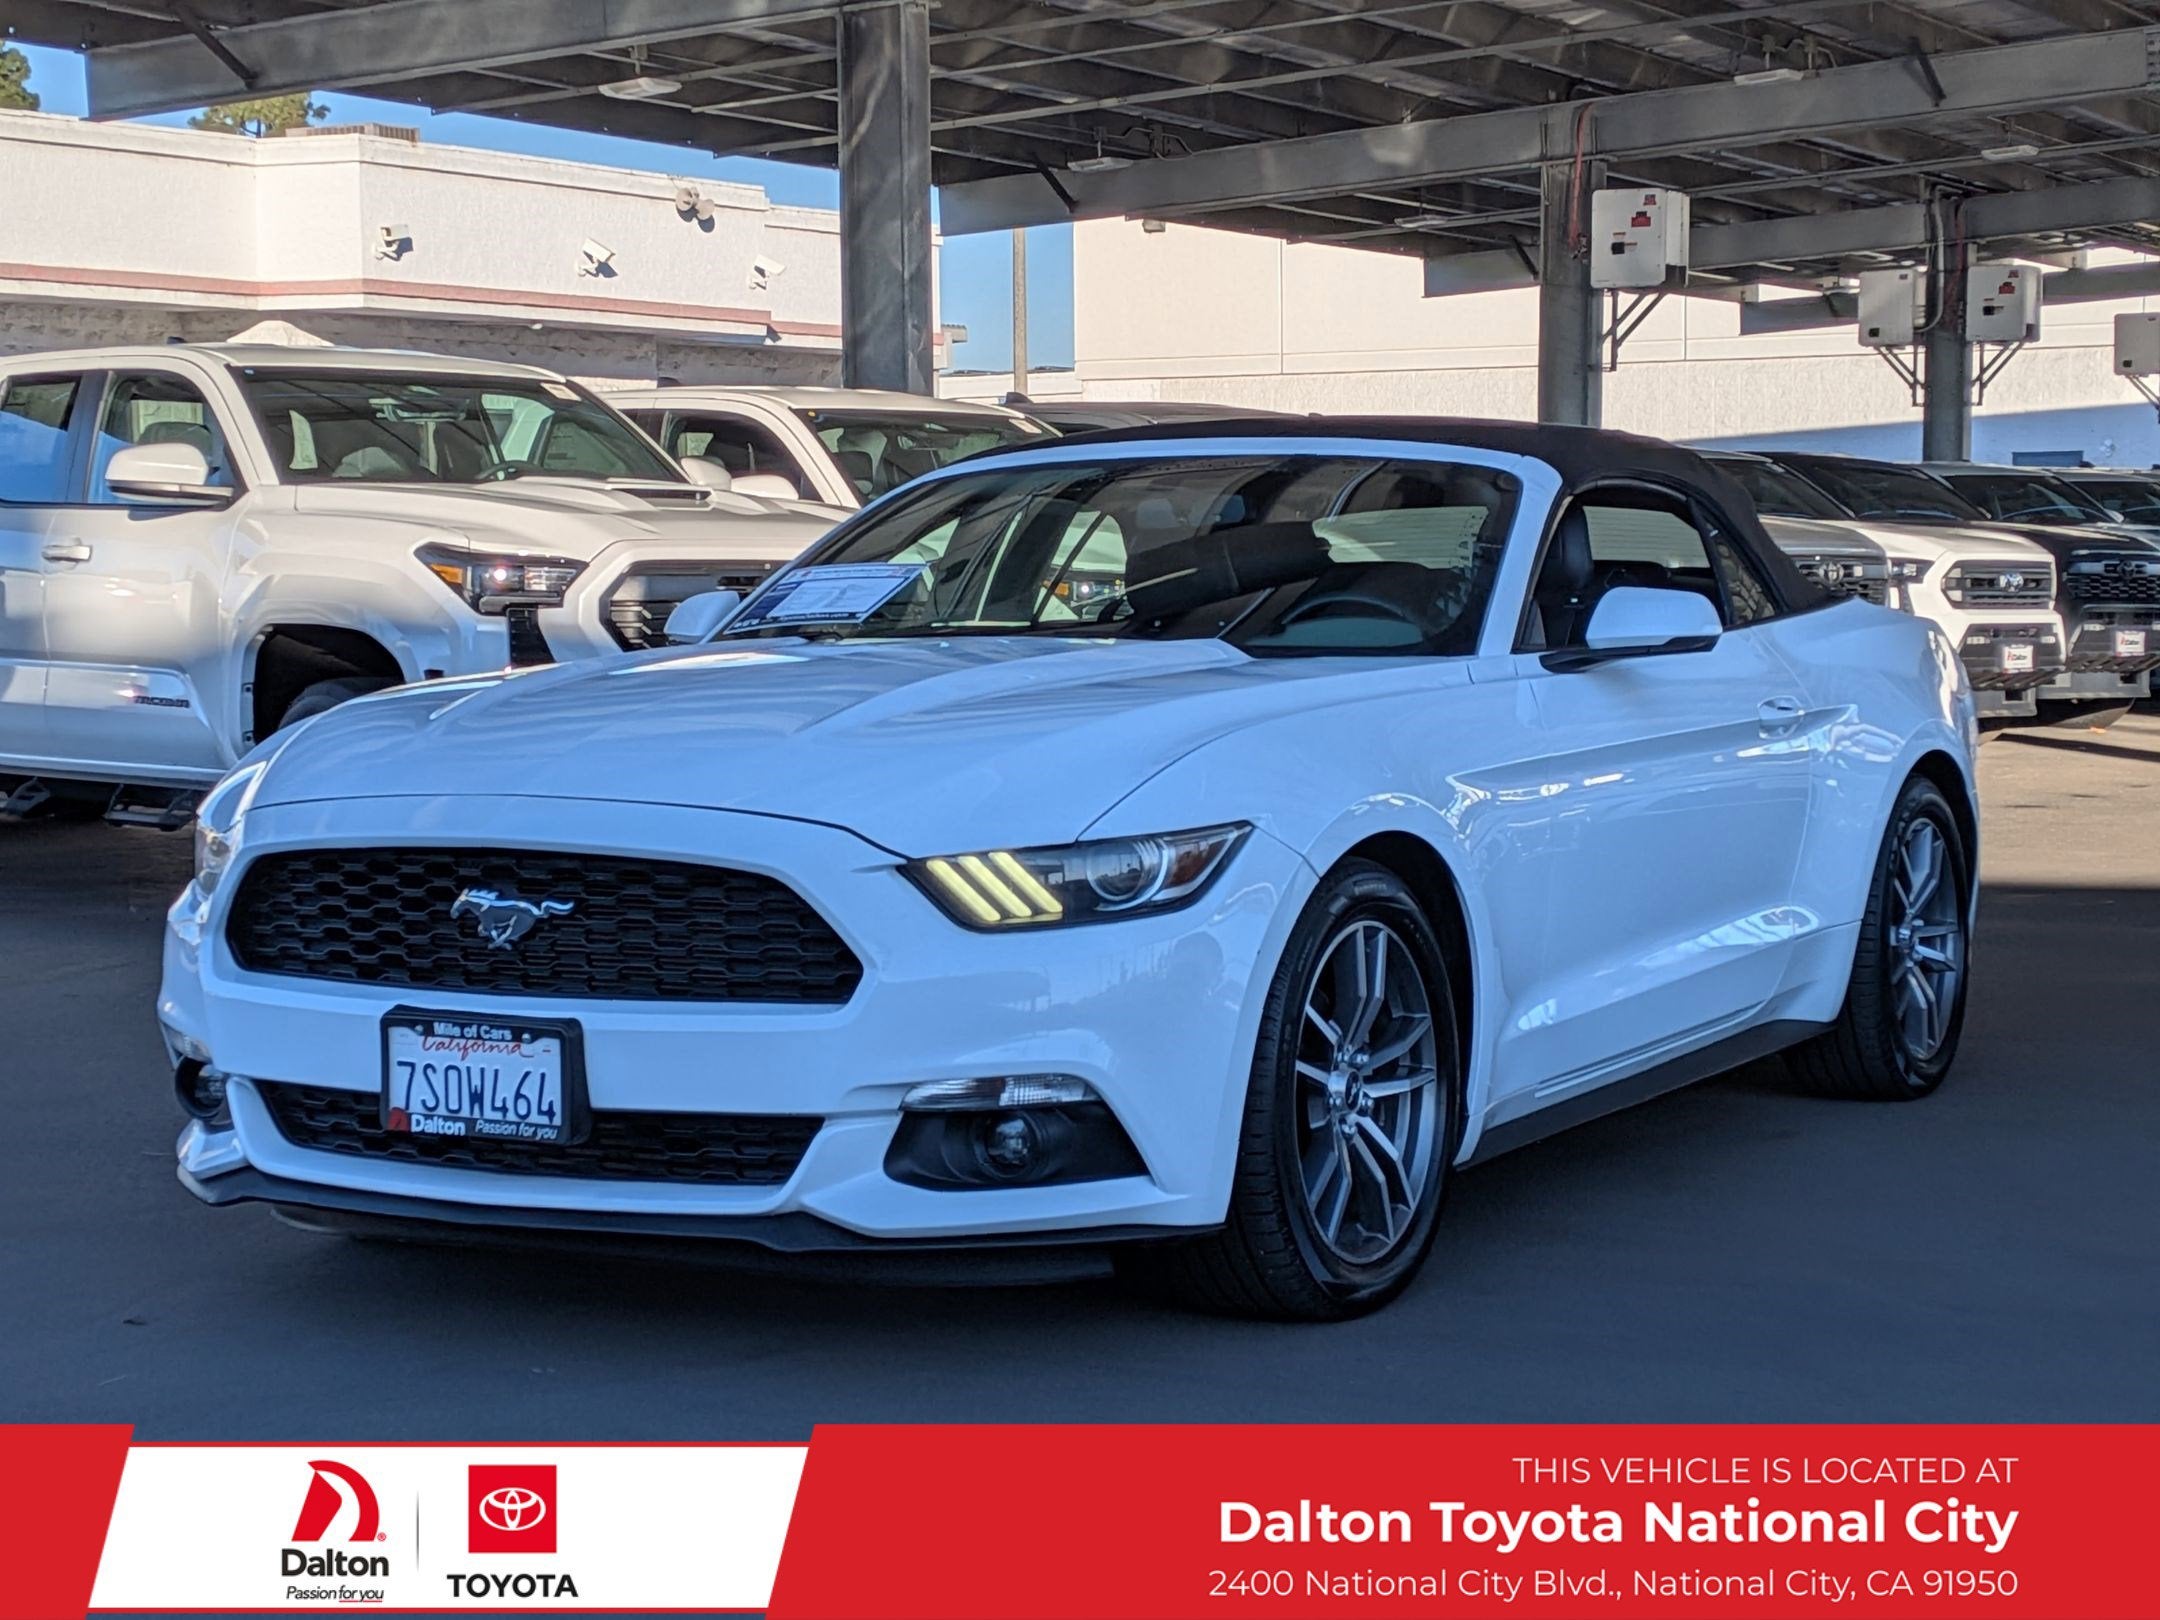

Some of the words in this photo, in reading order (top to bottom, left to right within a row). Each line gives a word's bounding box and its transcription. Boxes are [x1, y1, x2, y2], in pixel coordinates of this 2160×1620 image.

[432, 1022, 461, 1037] Mile
[464, 1024, 478, 1038] of
[480, 1026, 512, 1041] Cars
[396, 1060, 556, 1124] 7SOW464
[411, 1114, 466, 1136] Dalton
[475, 1119, 517, 1136] Passion
[518, 1121, 535, 1137] for
[536, 1127, 558, 1140] you
